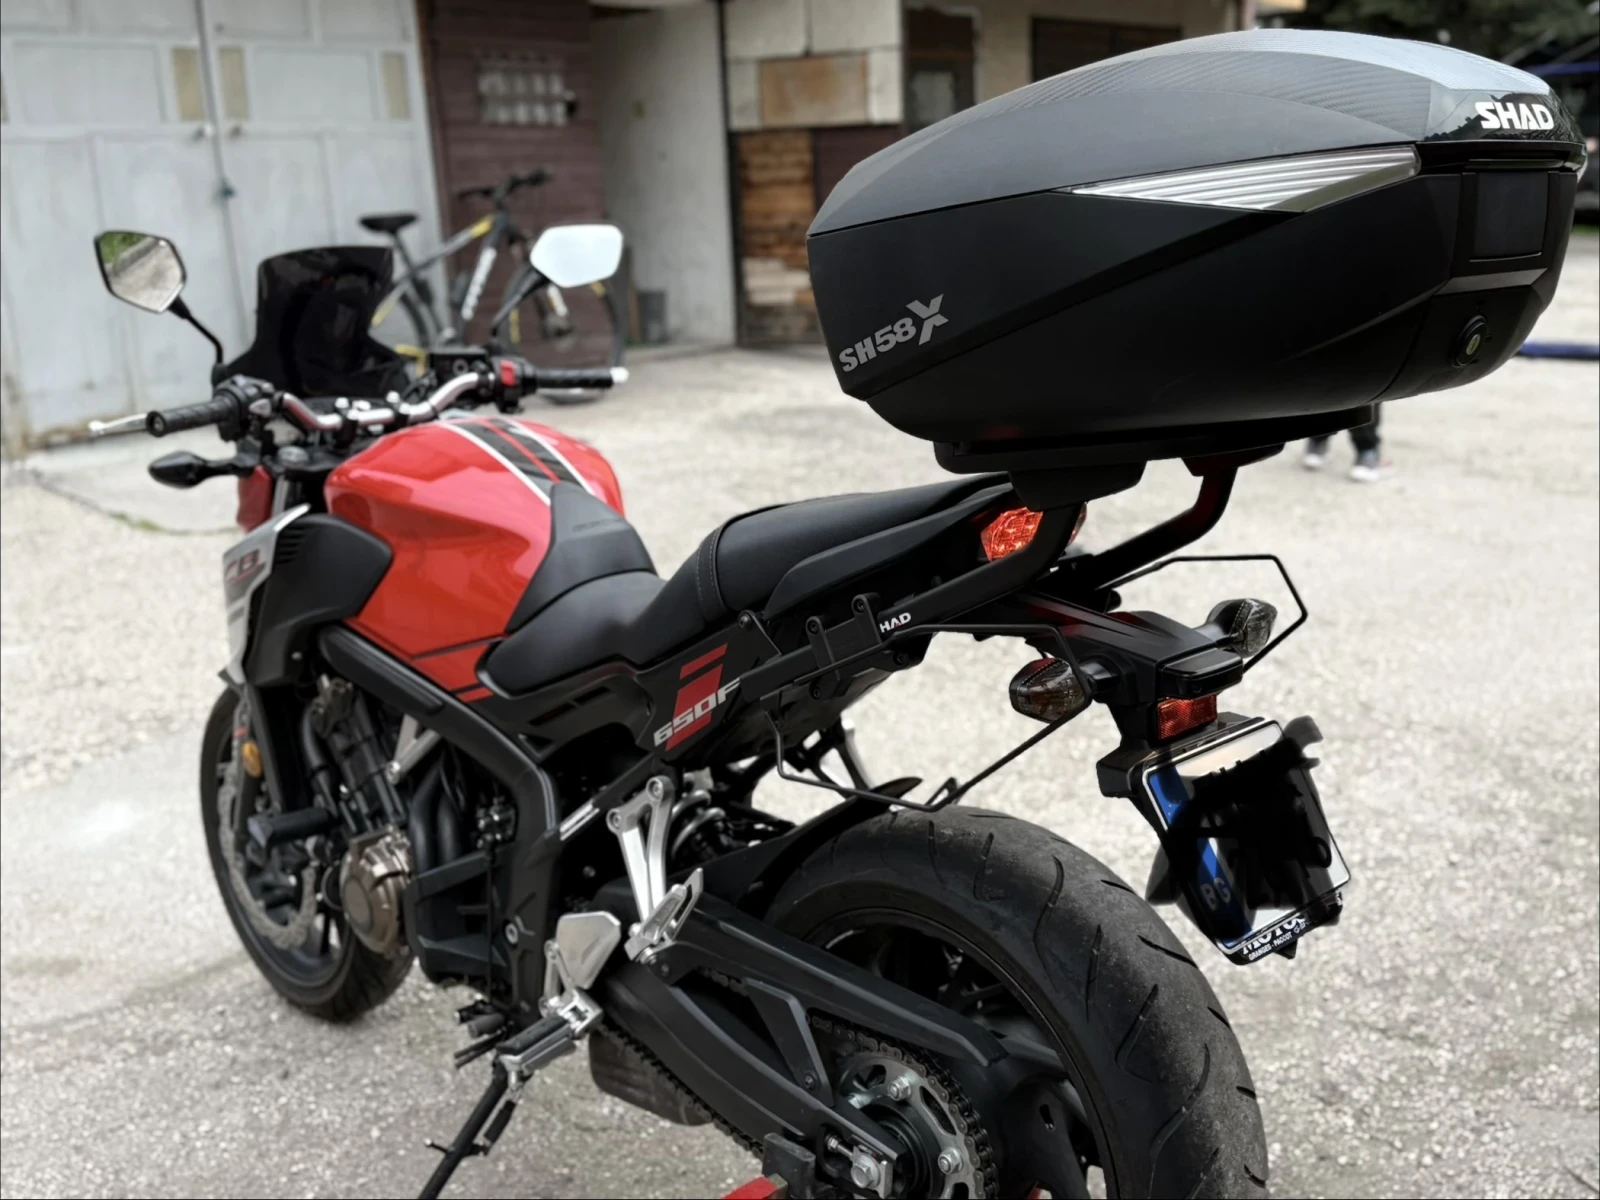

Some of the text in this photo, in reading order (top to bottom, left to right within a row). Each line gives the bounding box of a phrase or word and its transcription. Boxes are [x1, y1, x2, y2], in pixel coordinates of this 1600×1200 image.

[1475, 101, 1554, 130] SHAD
[879, 612, 912, 633] HAD
[653, 676, 741, 748] 650F
[1200, 876, 1231, 911] BG
[1248, 942, 1272, 961] GRANGES
[1273, 931, 1293, 947] PACCOT
